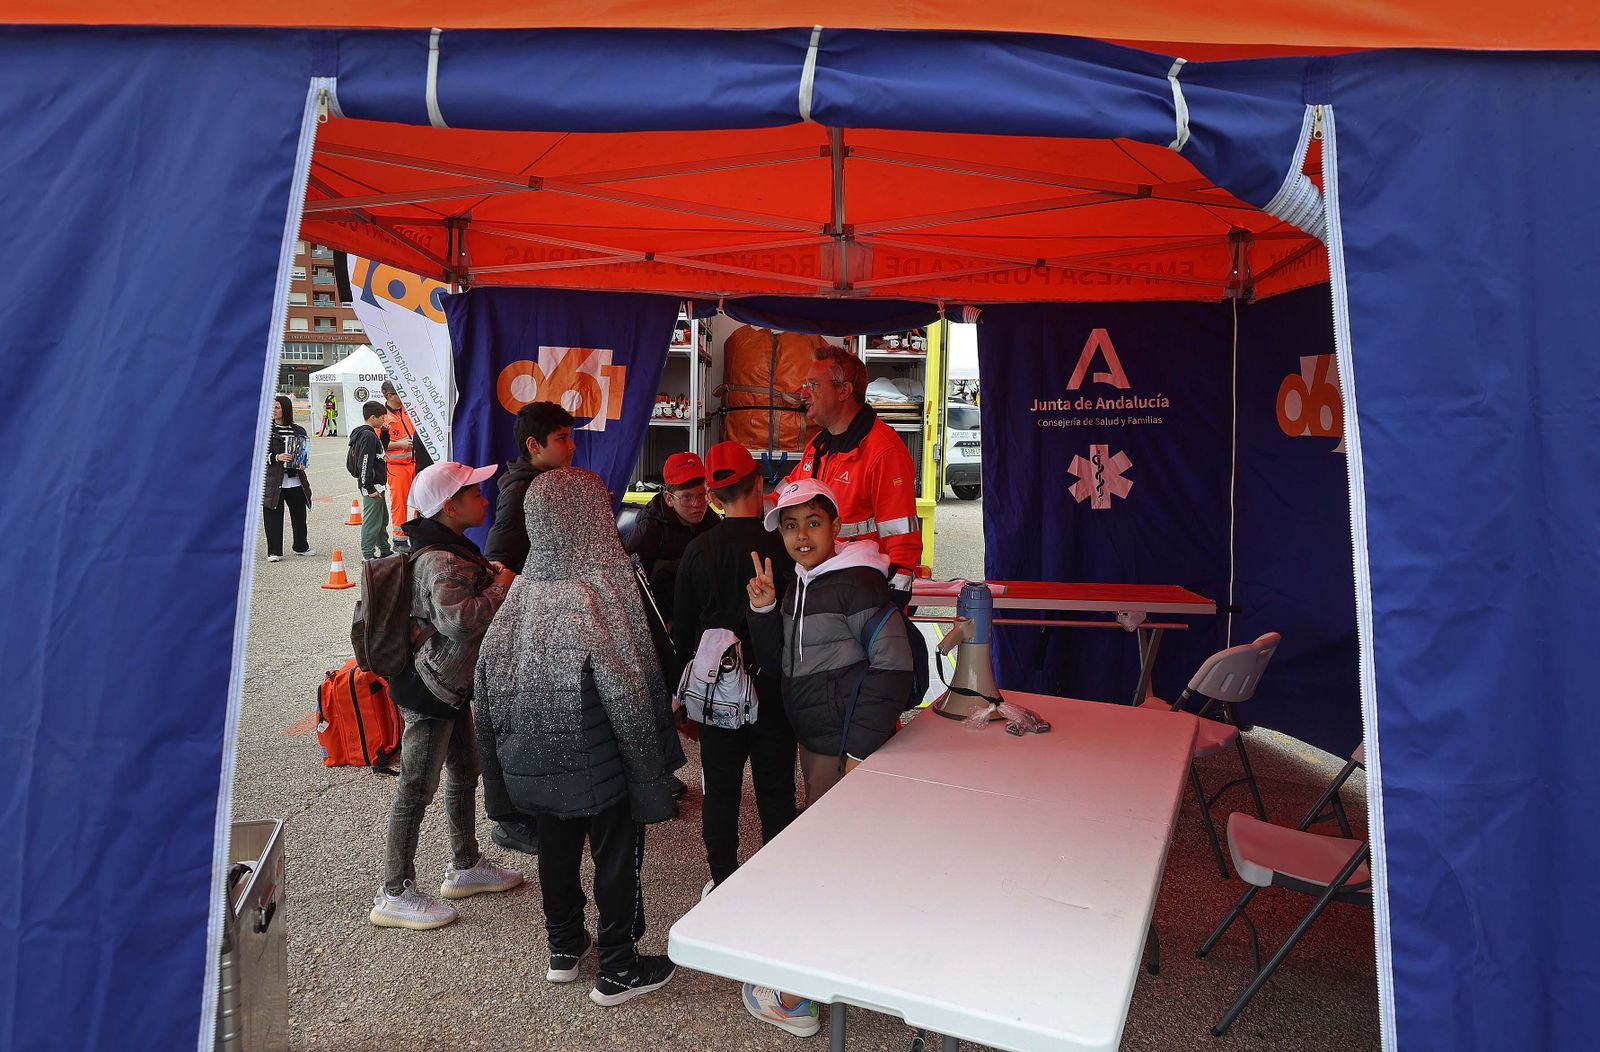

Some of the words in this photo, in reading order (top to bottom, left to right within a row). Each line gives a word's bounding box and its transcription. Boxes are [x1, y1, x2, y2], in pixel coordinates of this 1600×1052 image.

[315, 374, 337, 382] BOMBEROS
[358, 373, 389, 382] BOMBE
[497, 348, 627, 420] 061
[1030, 399, 1071, 411] Junta
[1075, 397, 1092, 410] de
[1096, 393, 1170, 410] Andalucía
[1276, 354, 1344, 437] 06
[1038, 417, 1080, 428] Consejería
[1083, 417, 1093, 426] de
[1095, 416, 1119, 426] Salud
[1121, 418, 1126, 427] y
[1128, 415, 1163, 425] Familias
